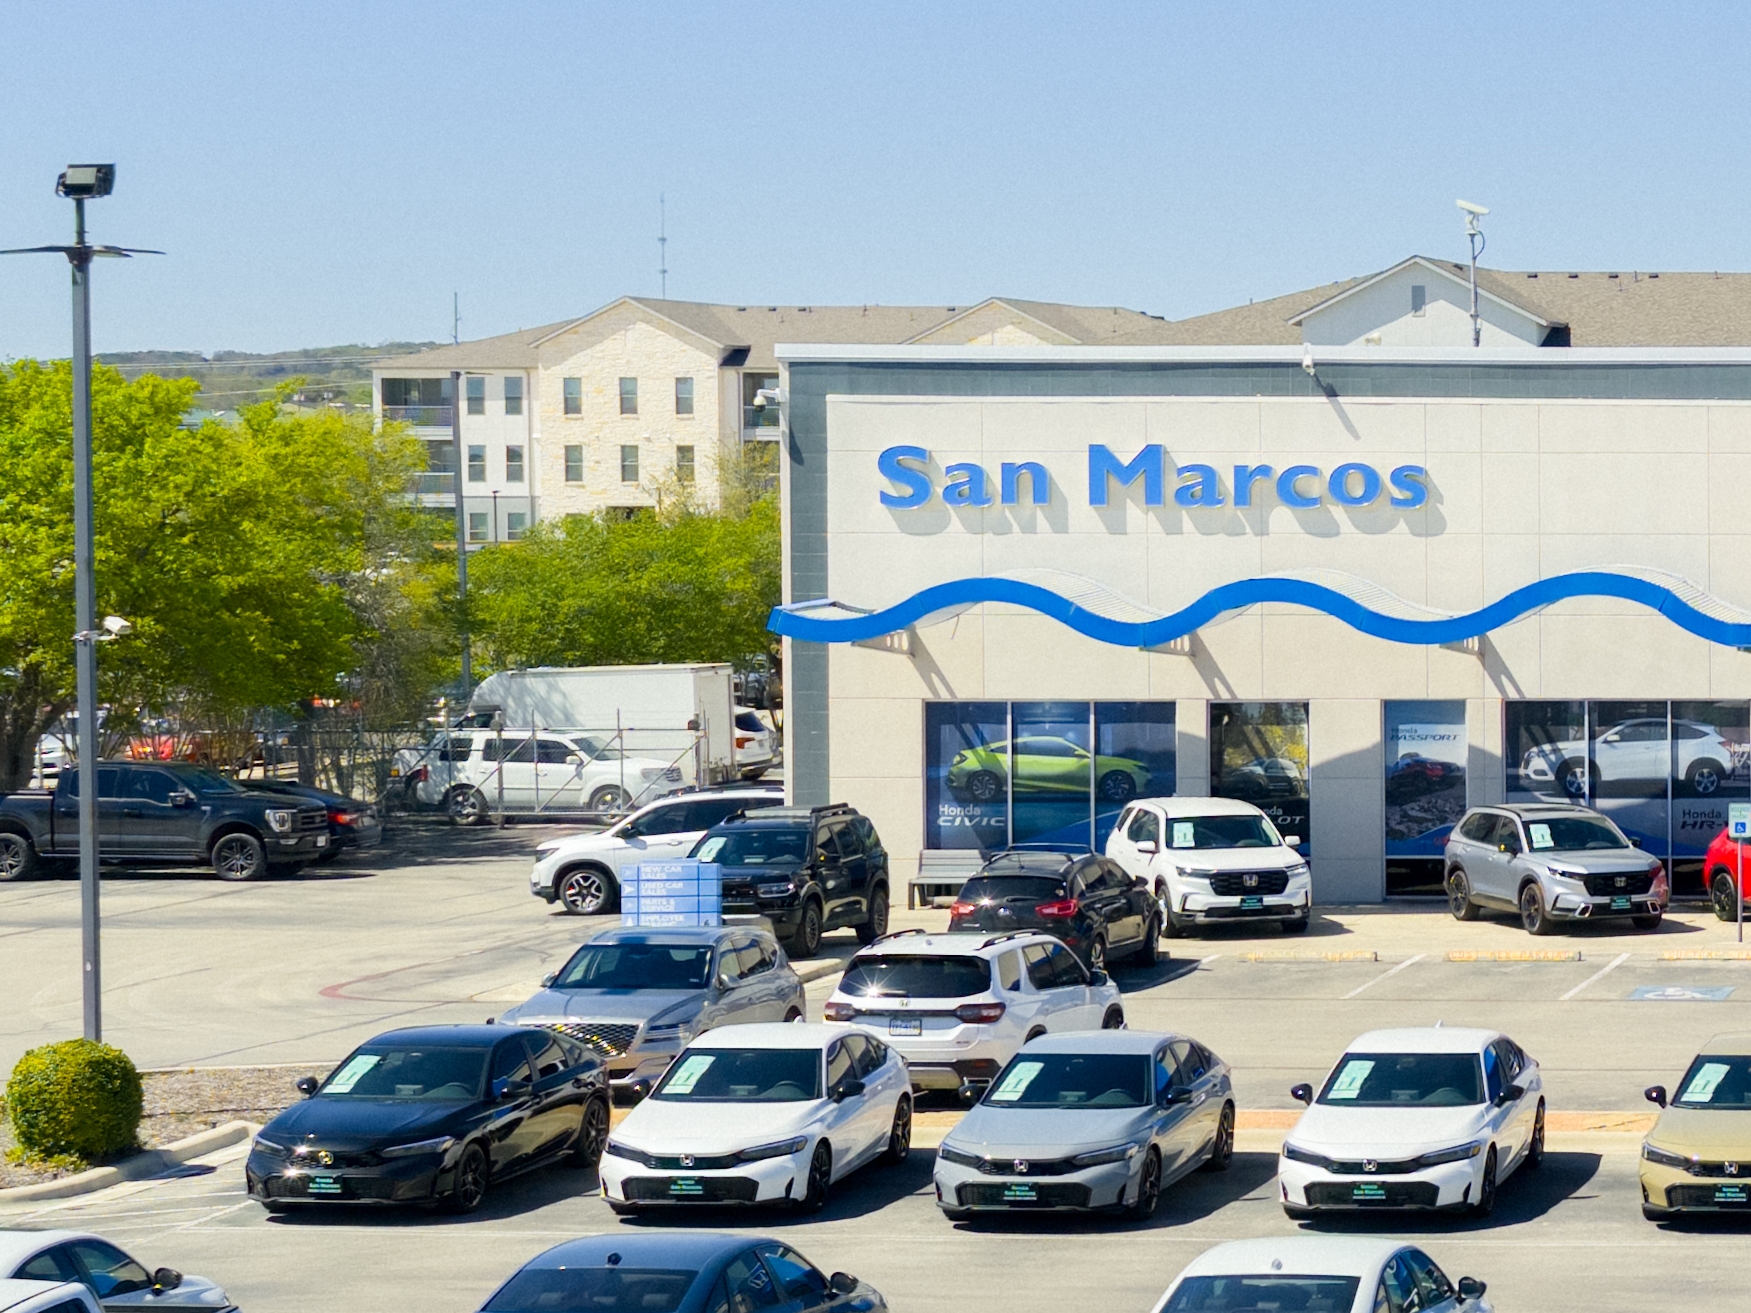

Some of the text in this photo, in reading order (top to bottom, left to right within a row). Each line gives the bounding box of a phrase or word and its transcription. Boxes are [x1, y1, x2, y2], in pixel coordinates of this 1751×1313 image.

[878, 444, 1429, 510] San Marcos
[938, 804, 982, 816] Honda
[1682, 809, 1722, 819] Honda
[936, 816, 1005, 826] CIVIC
